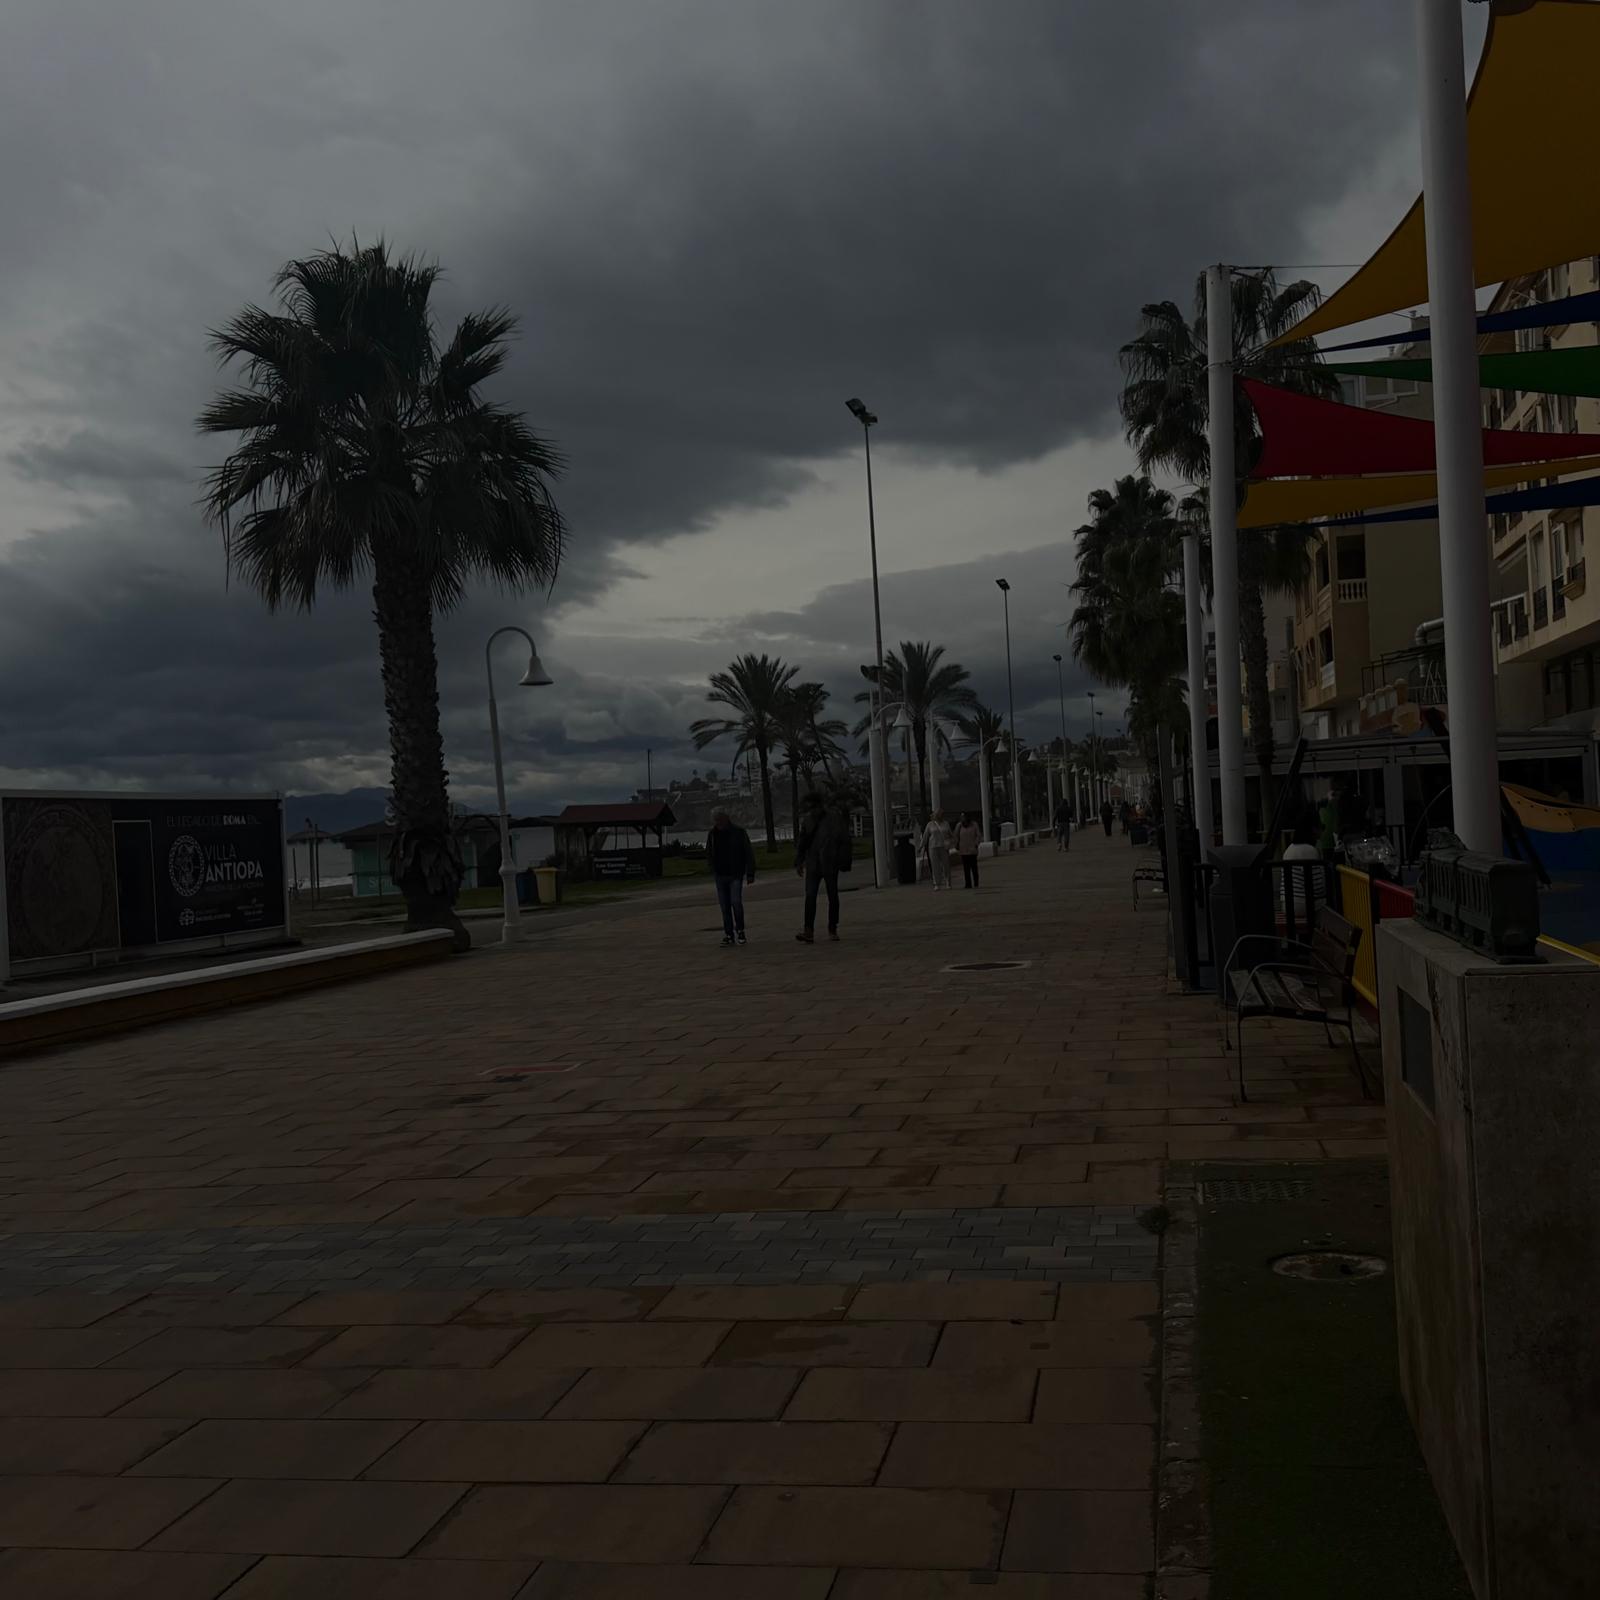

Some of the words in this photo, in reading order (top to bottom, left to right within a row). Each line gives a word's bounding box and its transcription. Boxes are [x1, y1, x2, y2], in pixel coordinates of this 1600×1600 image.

[223, 814, 246, 825] ROMA
[204, 842, 237, 860] VILLA
[205, 860, 264, 882] ANTIOPA
